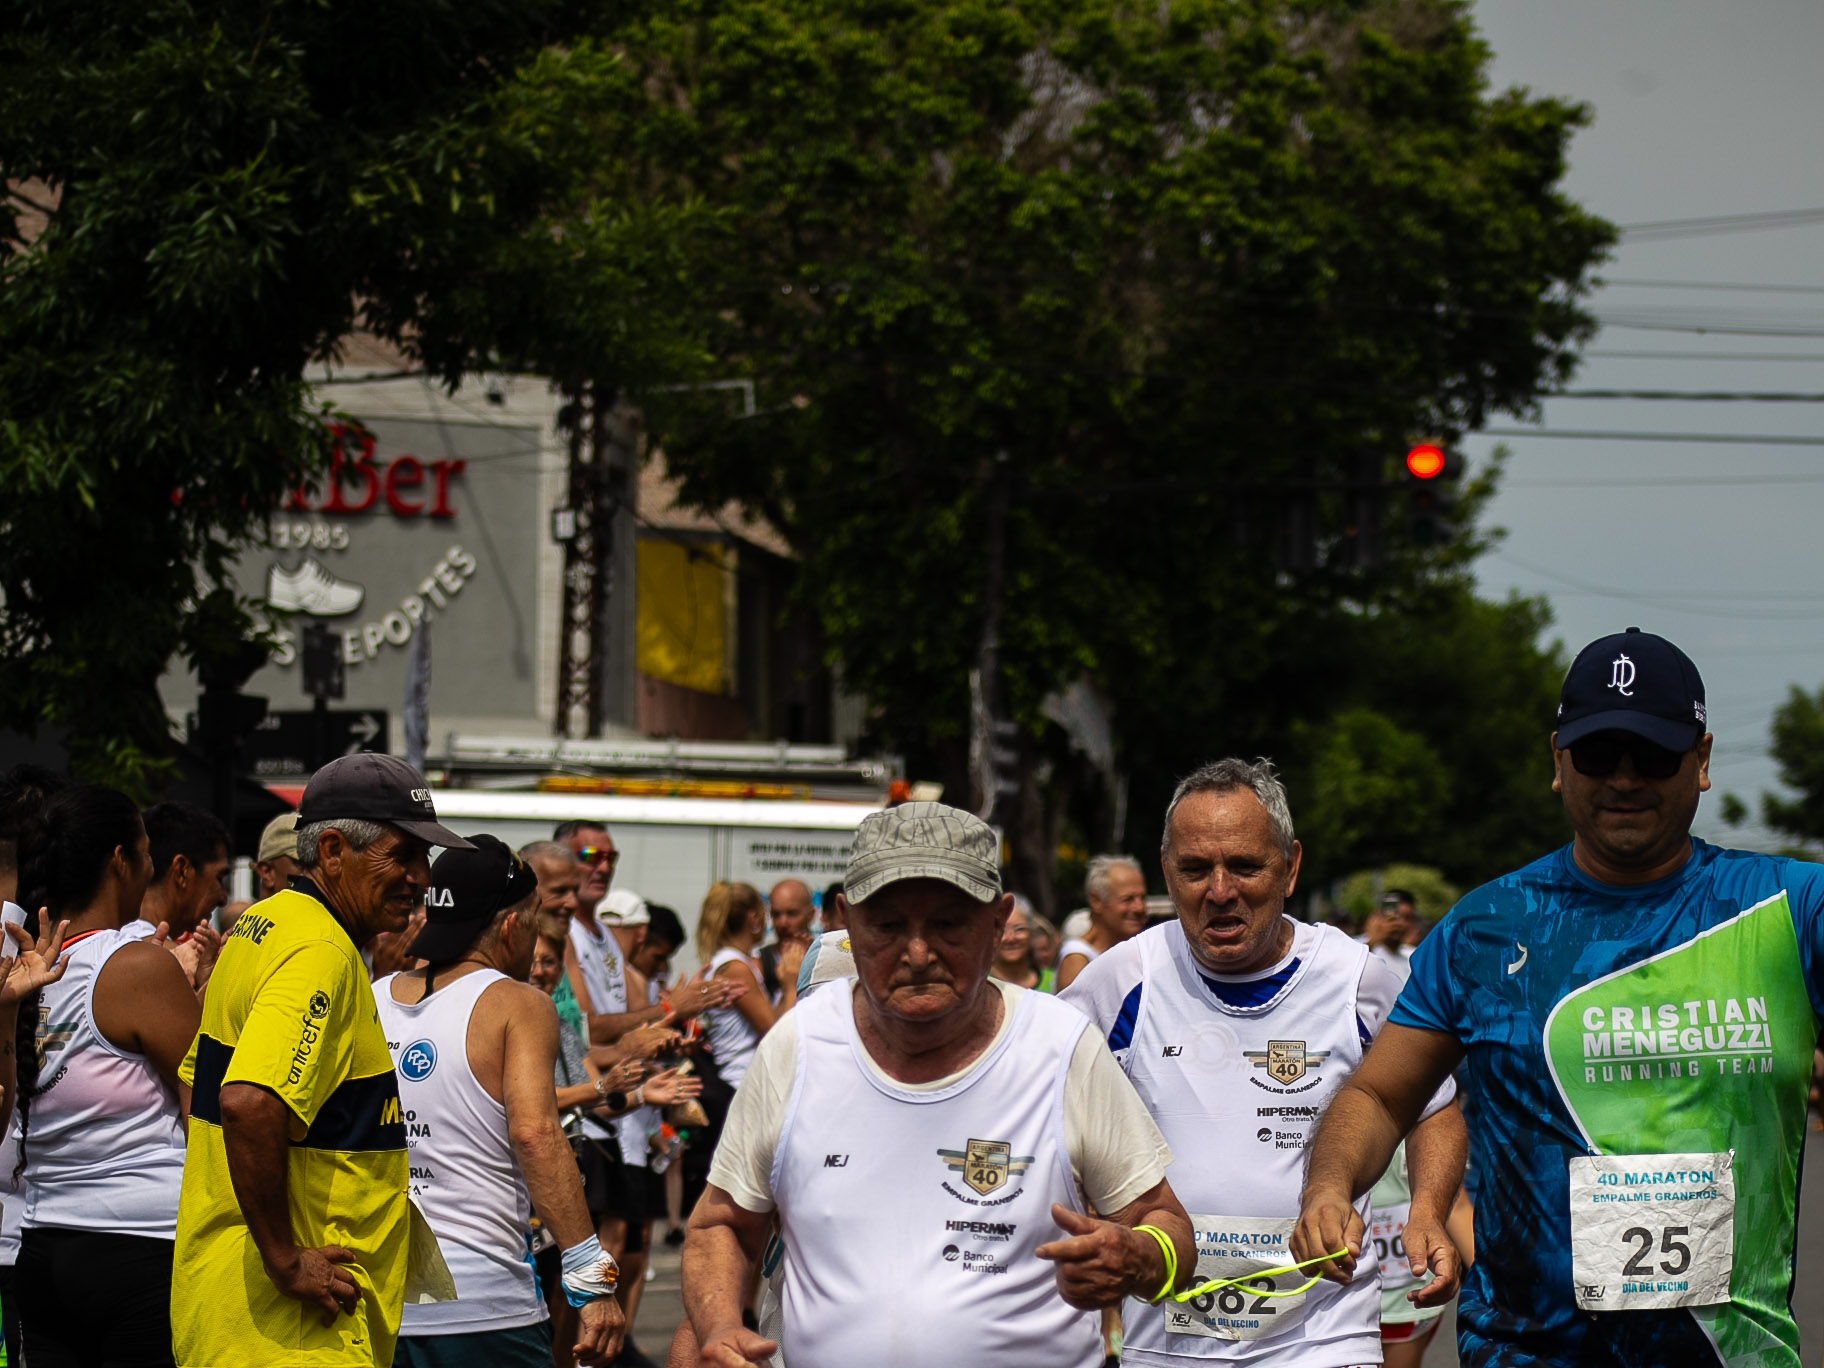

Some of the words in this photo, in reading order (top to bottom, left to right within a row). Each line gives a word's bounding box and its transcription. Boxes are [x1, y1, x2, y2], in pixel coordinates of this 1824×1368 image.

[274, 522, 350, 550] 1985
[341, 545, 477, 664] EPORTES
[1582, 997, 1767, 1031] CRISTIAN
[1583, 1024, 1772, 1057] MENEGUZZI
[288, 1014, 320, 1085] unicef
[1162, 1046, 1183, 1057] NEJ
[1275, 1064, 1298, 1077] 40
[1585, 1060, 1699, 1083] RUNNING
[1717, 1057, 1773, 1074] TEAM
[1250, 1077, 1284, 1095] EMPALME
[1285, 1076, 1323, 1094] GRANEROS
[1276, 1132, 1303, 1140] Banco
[972, 1144, 1005, 1153] ARGENTINA
[824, 1155, 849, 1168] NEJ
[972, 1170, 998, 1186] 40
[1597, 1173, 1618, 1186] 40
[1624, 1171, 1714, 1185] MARATON
[941, 1181, 979, 1206] EMPALME
[980, 1187, 1024, 1207] GRANEROS
[1593, 1192, 1651, 1203] EMPALME
[1655, 1190, 1717, 1201] GRANEROS
[1206, 1232, 1282, 1245] MARATON
[963, 1251, 994, 1262] Banco
[1231, 1250, 1287, 1259] GRANEROS
[1622, 1226, 1691, 1276] 25
[962, 1262, 1008, 1275] Municipal
[1583, 1286, 1605, 1298] NEJ
[1622, 1284, 1637, 1294] DIA
[1639, 1283, 1655, 1293] DEL
[1657, 1281, 1688, 1292] VECINO
[1172, 1313, 1192, 1323] NEJ
[1204, 1317, 1216, 1326] DIA
[1218, 1318, 1230, 1327] DEL
[1231, 1319, 1259, 1329] VECINO
